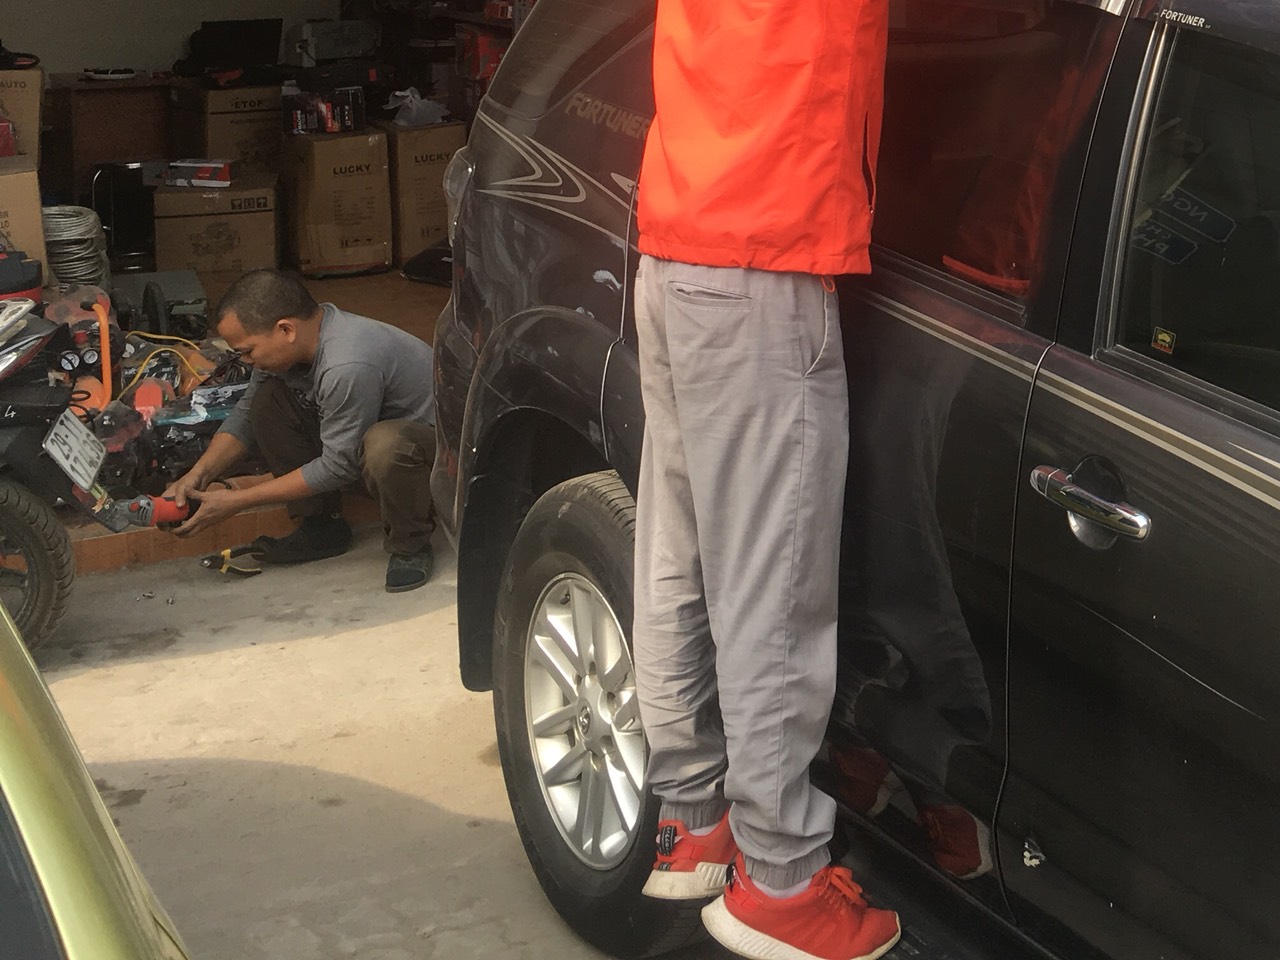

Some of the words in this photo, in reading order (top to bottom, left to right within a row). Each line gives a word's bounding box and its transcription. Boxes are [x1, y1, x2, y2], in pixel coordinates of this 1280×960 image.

[1160, 9, 1206, 28] FORTUNER
[414, 151, 450, 164] LUCKY
[333, 163, 371, 176] LUCKY
